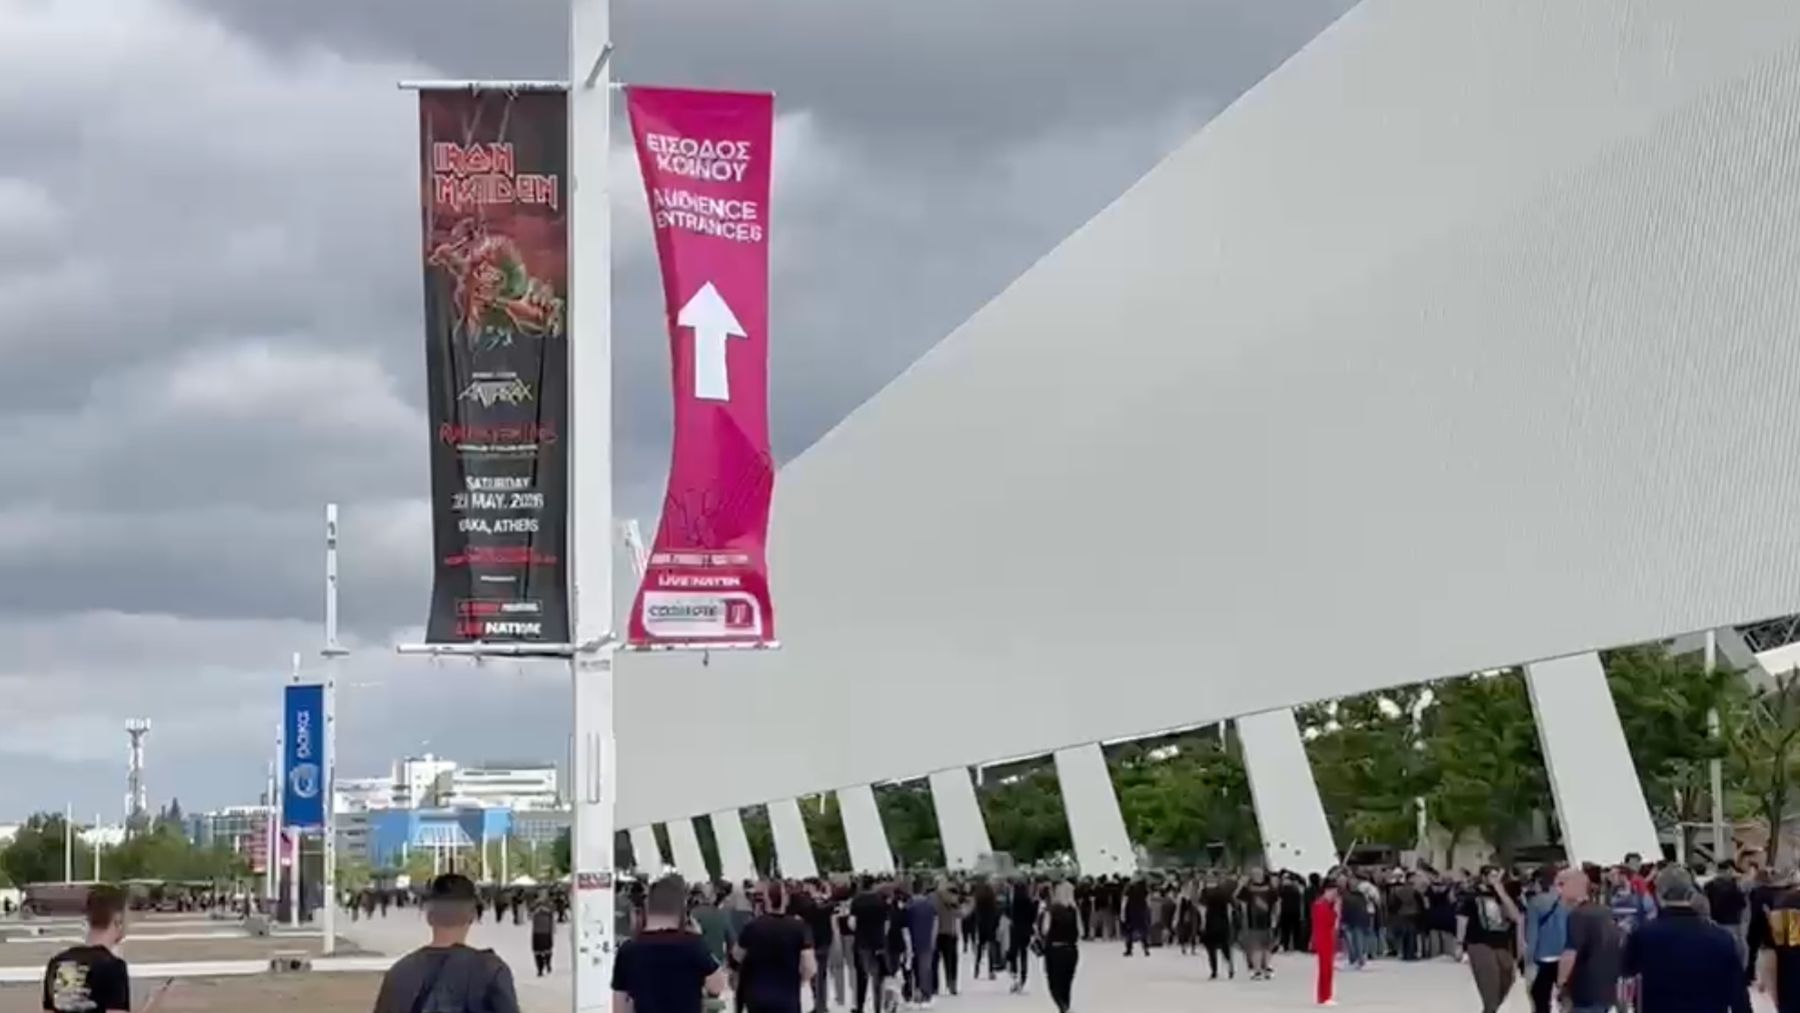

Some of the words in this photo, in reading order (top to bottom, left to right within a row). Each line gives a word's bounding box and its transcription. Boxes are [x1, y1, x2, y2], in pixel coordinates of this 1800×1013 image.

[433, 142, 514, 178] IRON
[646, 133, 751, 160] ΕΙΣΟΔΟΣ
[656, 153, 747, 181] ΚΟΙΝΟΥ
[433, 174, 558, 211] MAIDEN
[653, 187, 758, 220] AUDIENCE
[465, 475, 532, 491] SATURDAY
[493, 518, 539, 533] ATHENS
